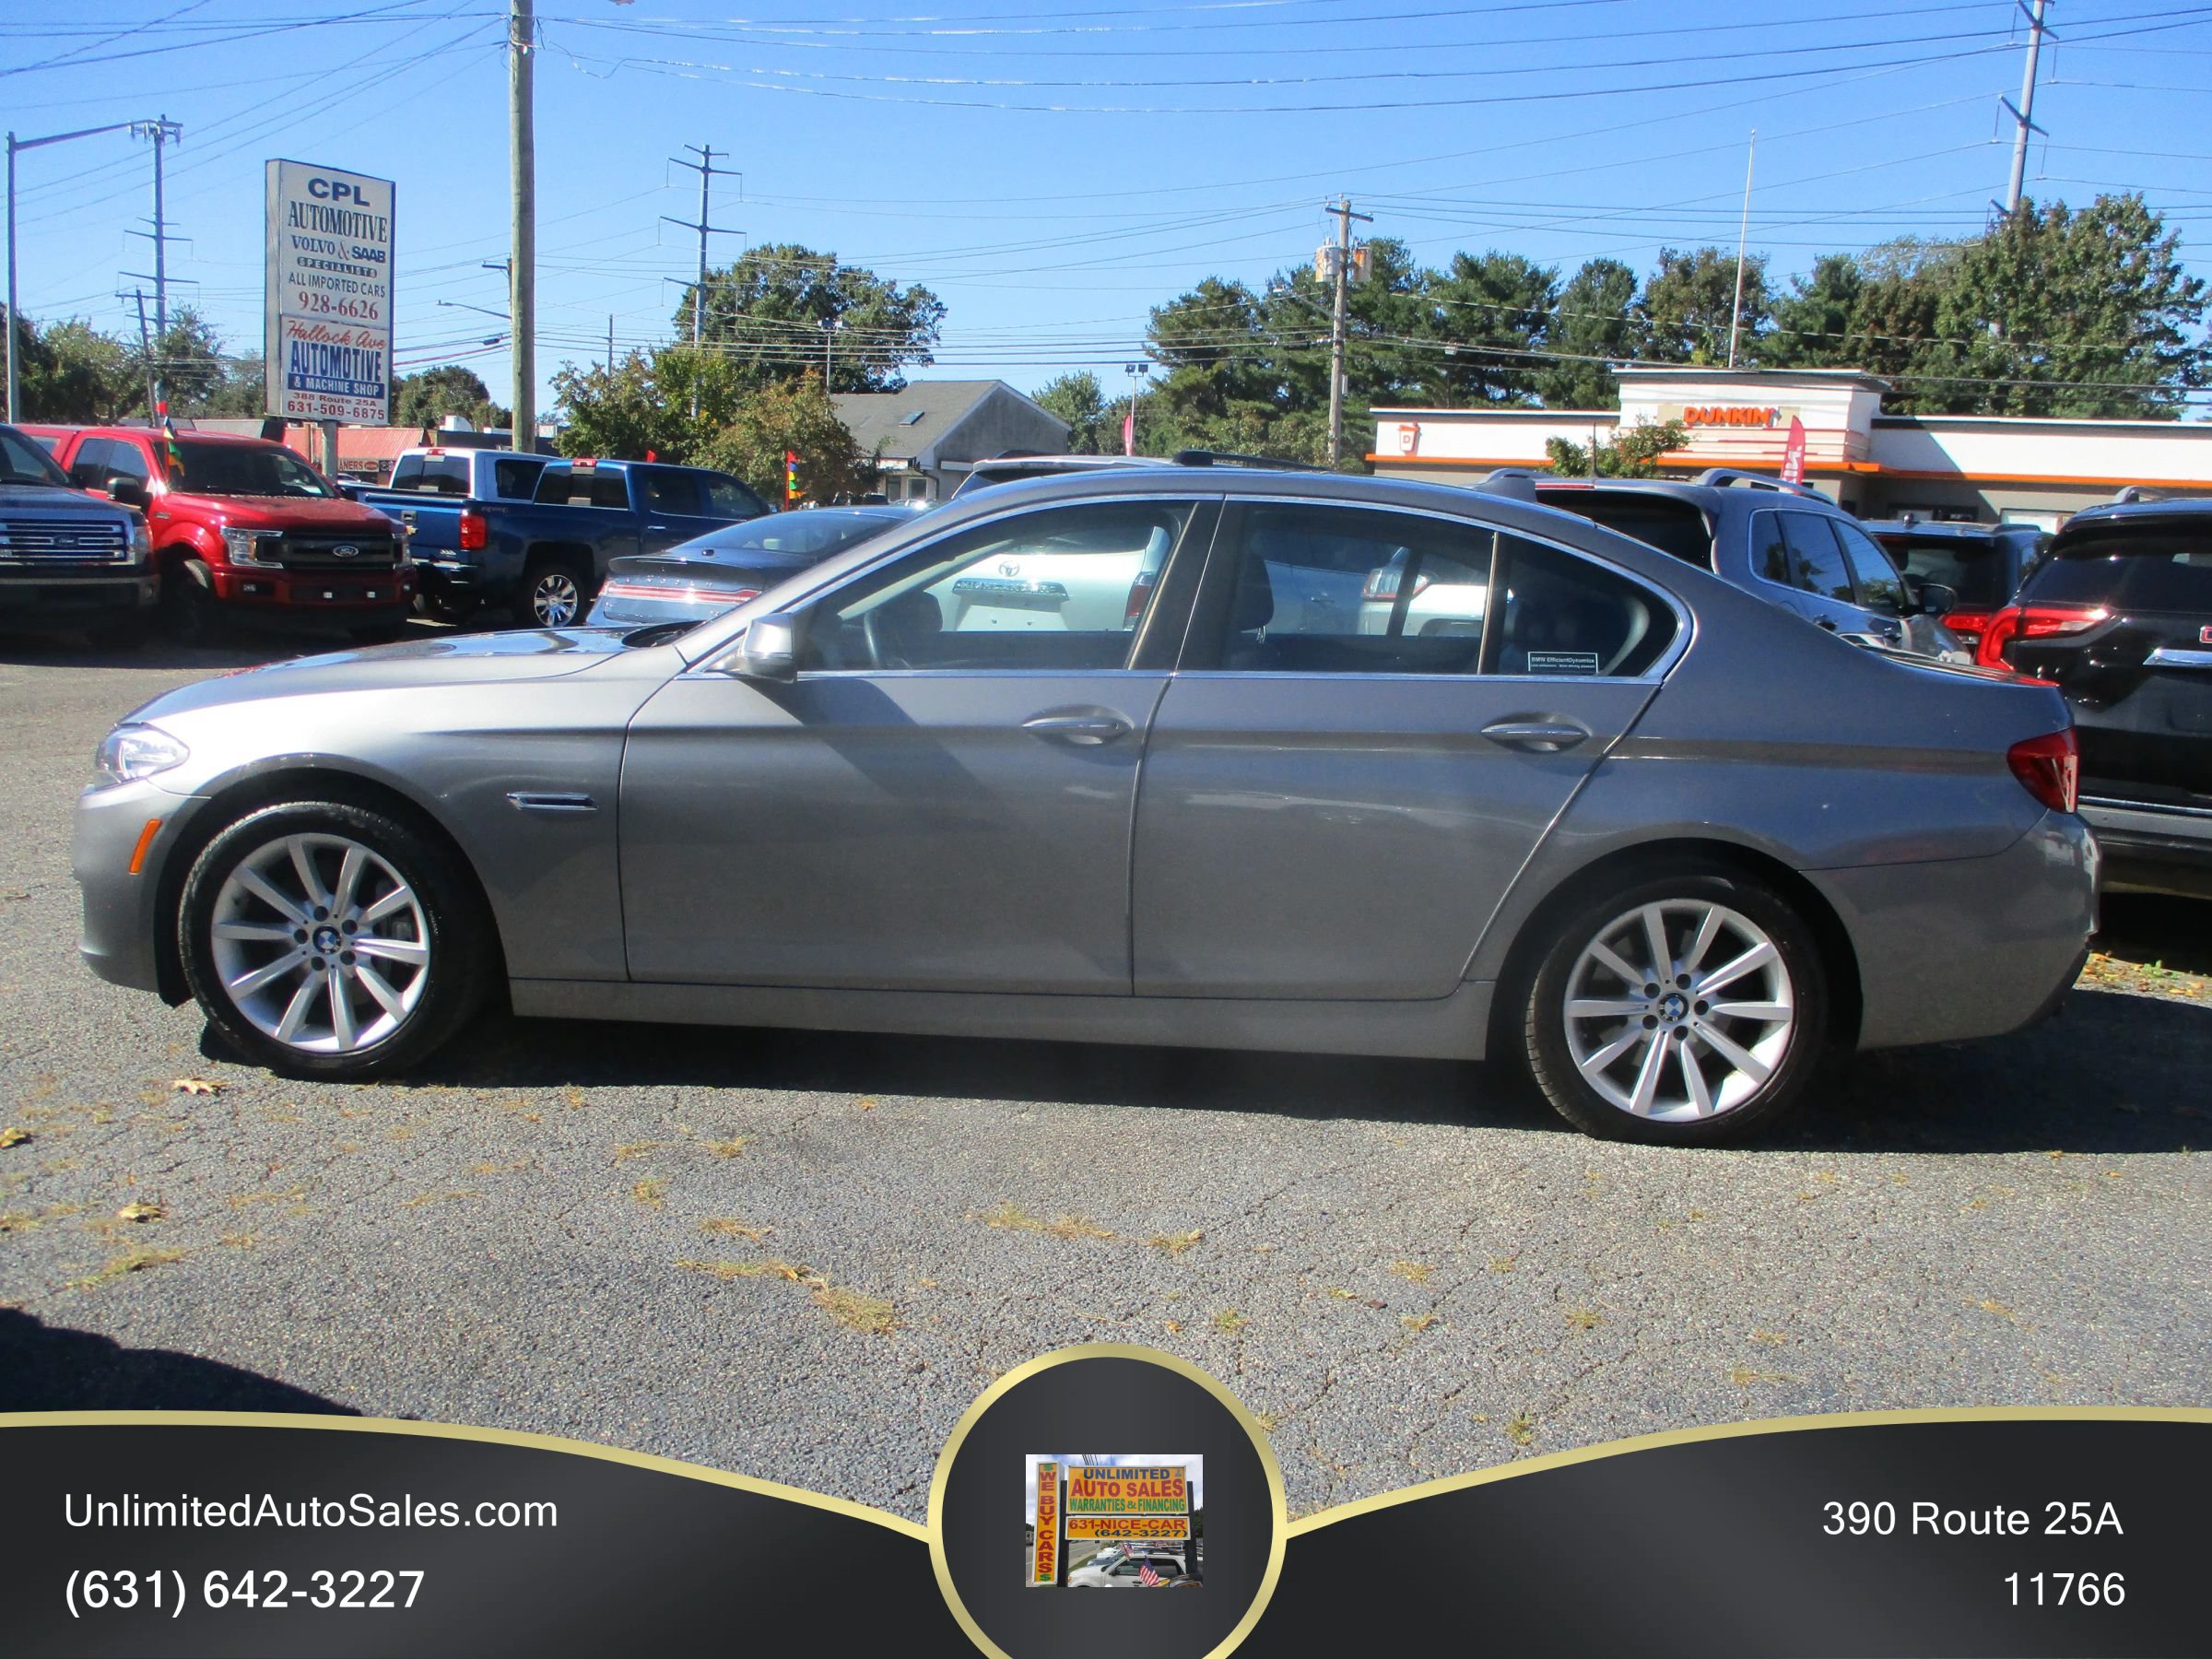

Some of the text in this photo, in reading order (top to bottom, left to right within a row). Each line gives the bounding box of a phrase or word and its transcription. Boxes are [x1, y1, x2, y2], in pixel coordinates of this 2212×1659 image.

[308, 178, 371, 206] CPL
[288, 201, 387, 243] AUTOMOTIVE
[291, 234, 386, 264] VOLVO & SAAB
[298, 257, 377, 277] SPECIALISTS
[288, 272, 386, 299] ALL IMPORTED CARS
[299, 290, 379, 320] 928-6626
[287, 320, 386, 350] Hallock Ave
[291, 340, 382, 382] AUTOMOTIVE
[294, 392, 377, 407] 388 Route 25A
[295, 376, 380, 397] & MACHINE SHOP
[288, 400, 385, 420] 631-509-6875
